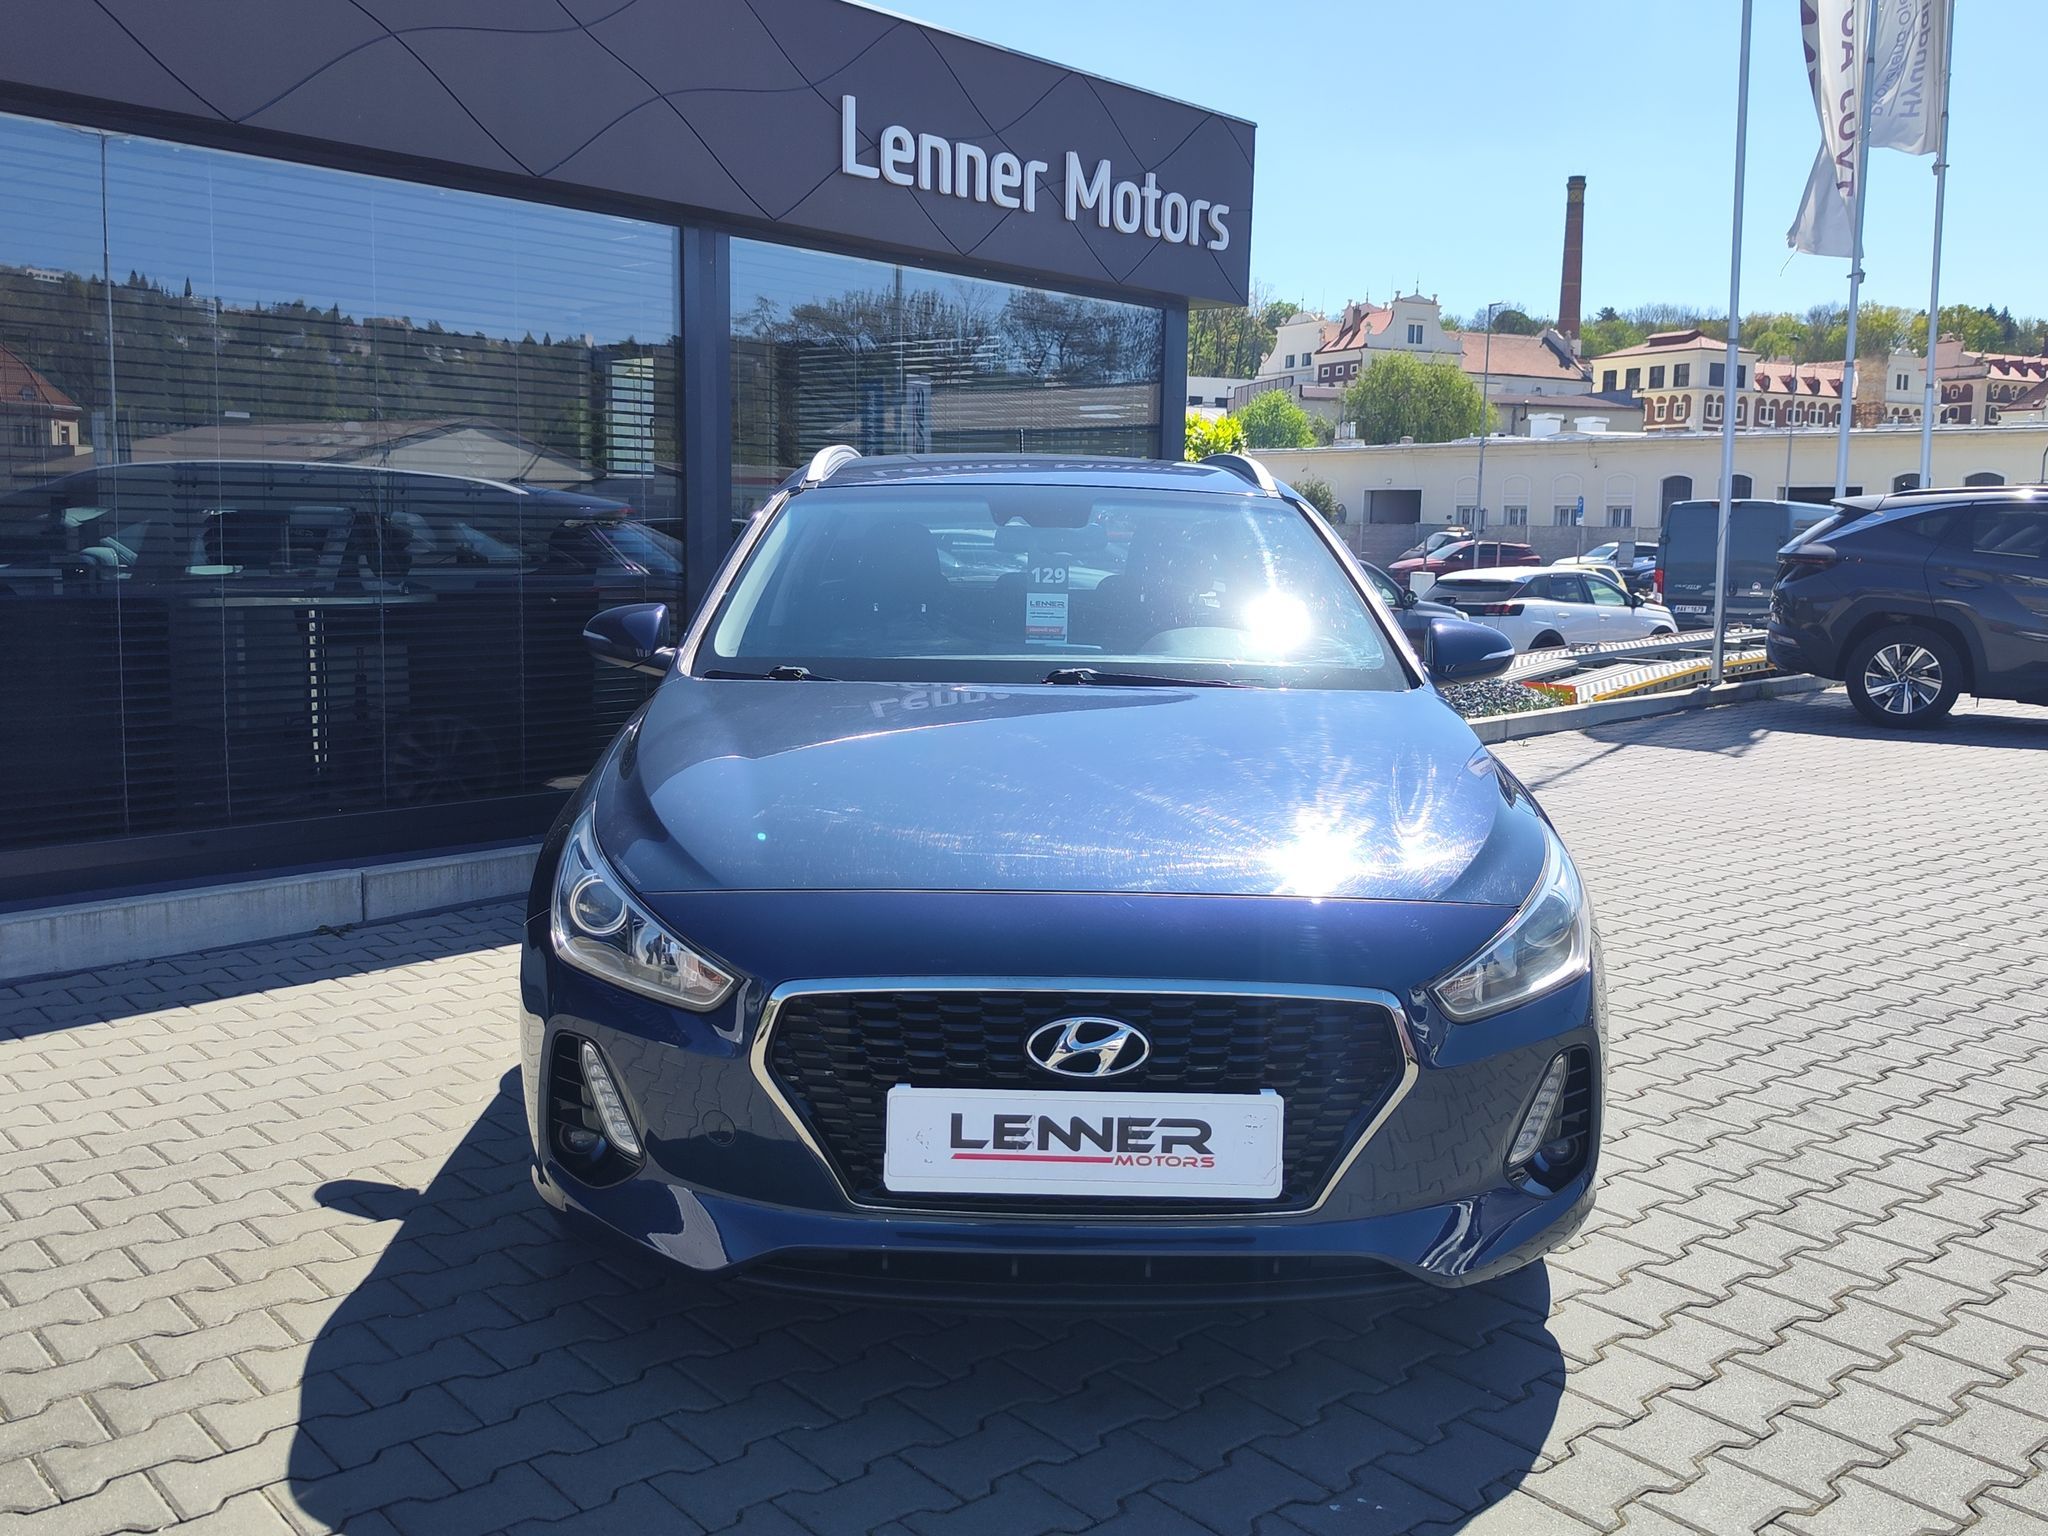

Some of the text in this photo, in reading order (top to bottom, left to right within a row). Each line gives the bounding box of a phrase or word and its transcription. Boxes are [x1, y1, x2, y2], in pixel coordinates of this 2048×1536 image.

[842, 94, 1231, 251] Lenner Motors
[1031, 567, 1066, 584] 129
[950, 1113, 1215, 1154] LENNER
[1112, 1155, 1215, 1168] MOTORS
